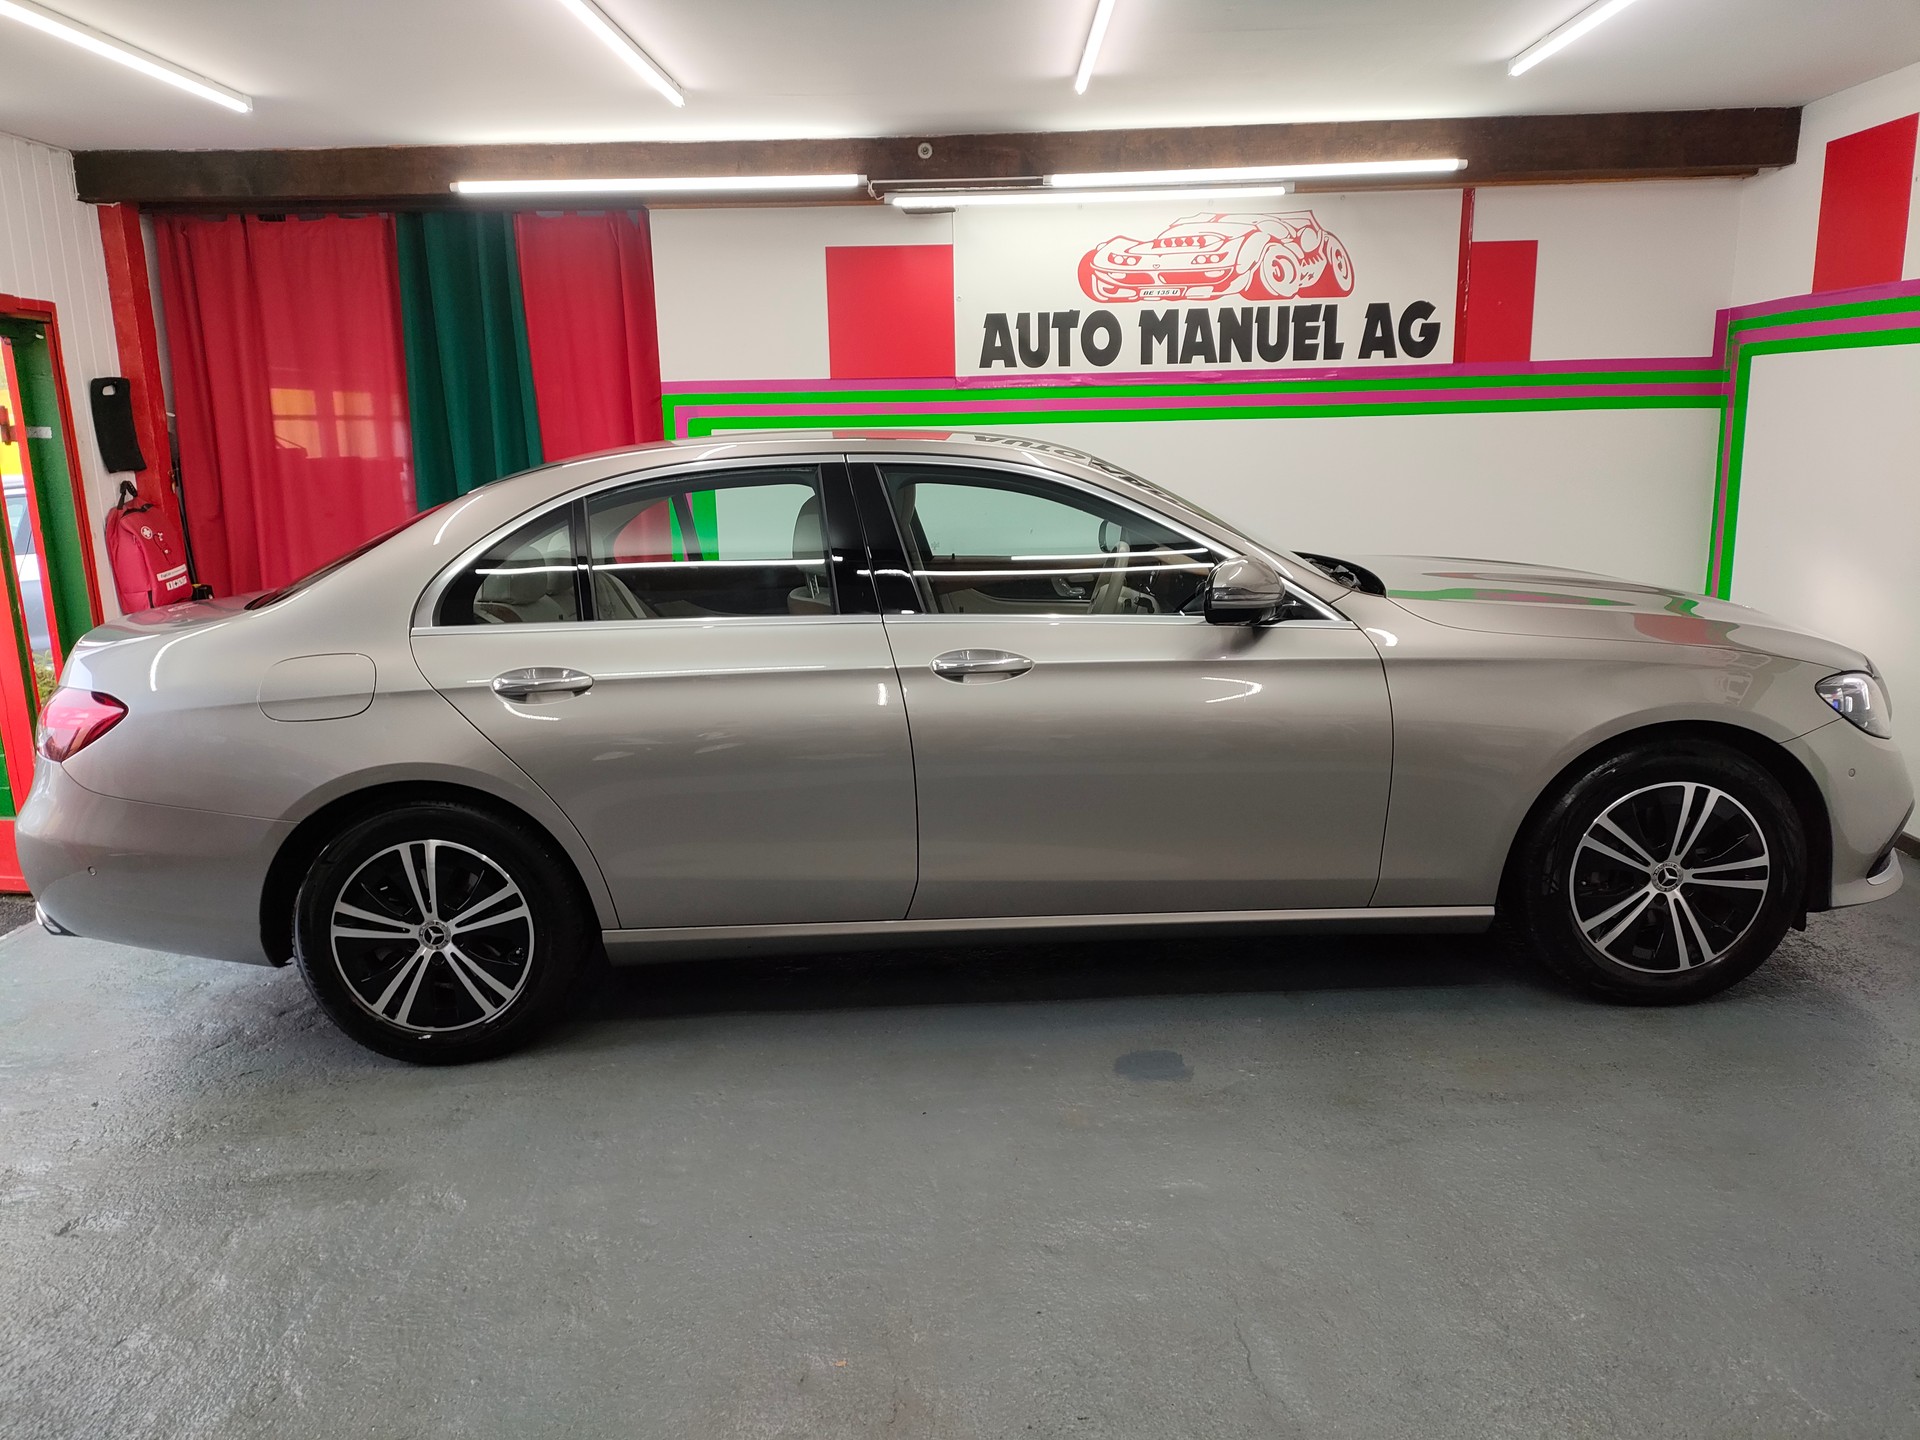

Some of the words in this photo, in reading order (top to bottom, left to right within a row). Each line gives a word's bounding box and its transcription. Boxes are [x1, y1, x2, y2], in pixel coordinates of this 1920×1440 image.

[979, 310, 1122, 368] AUTO
[1138, 304, 1345, 365] MANUEL
[1357, 300, 1441, 360] AG
